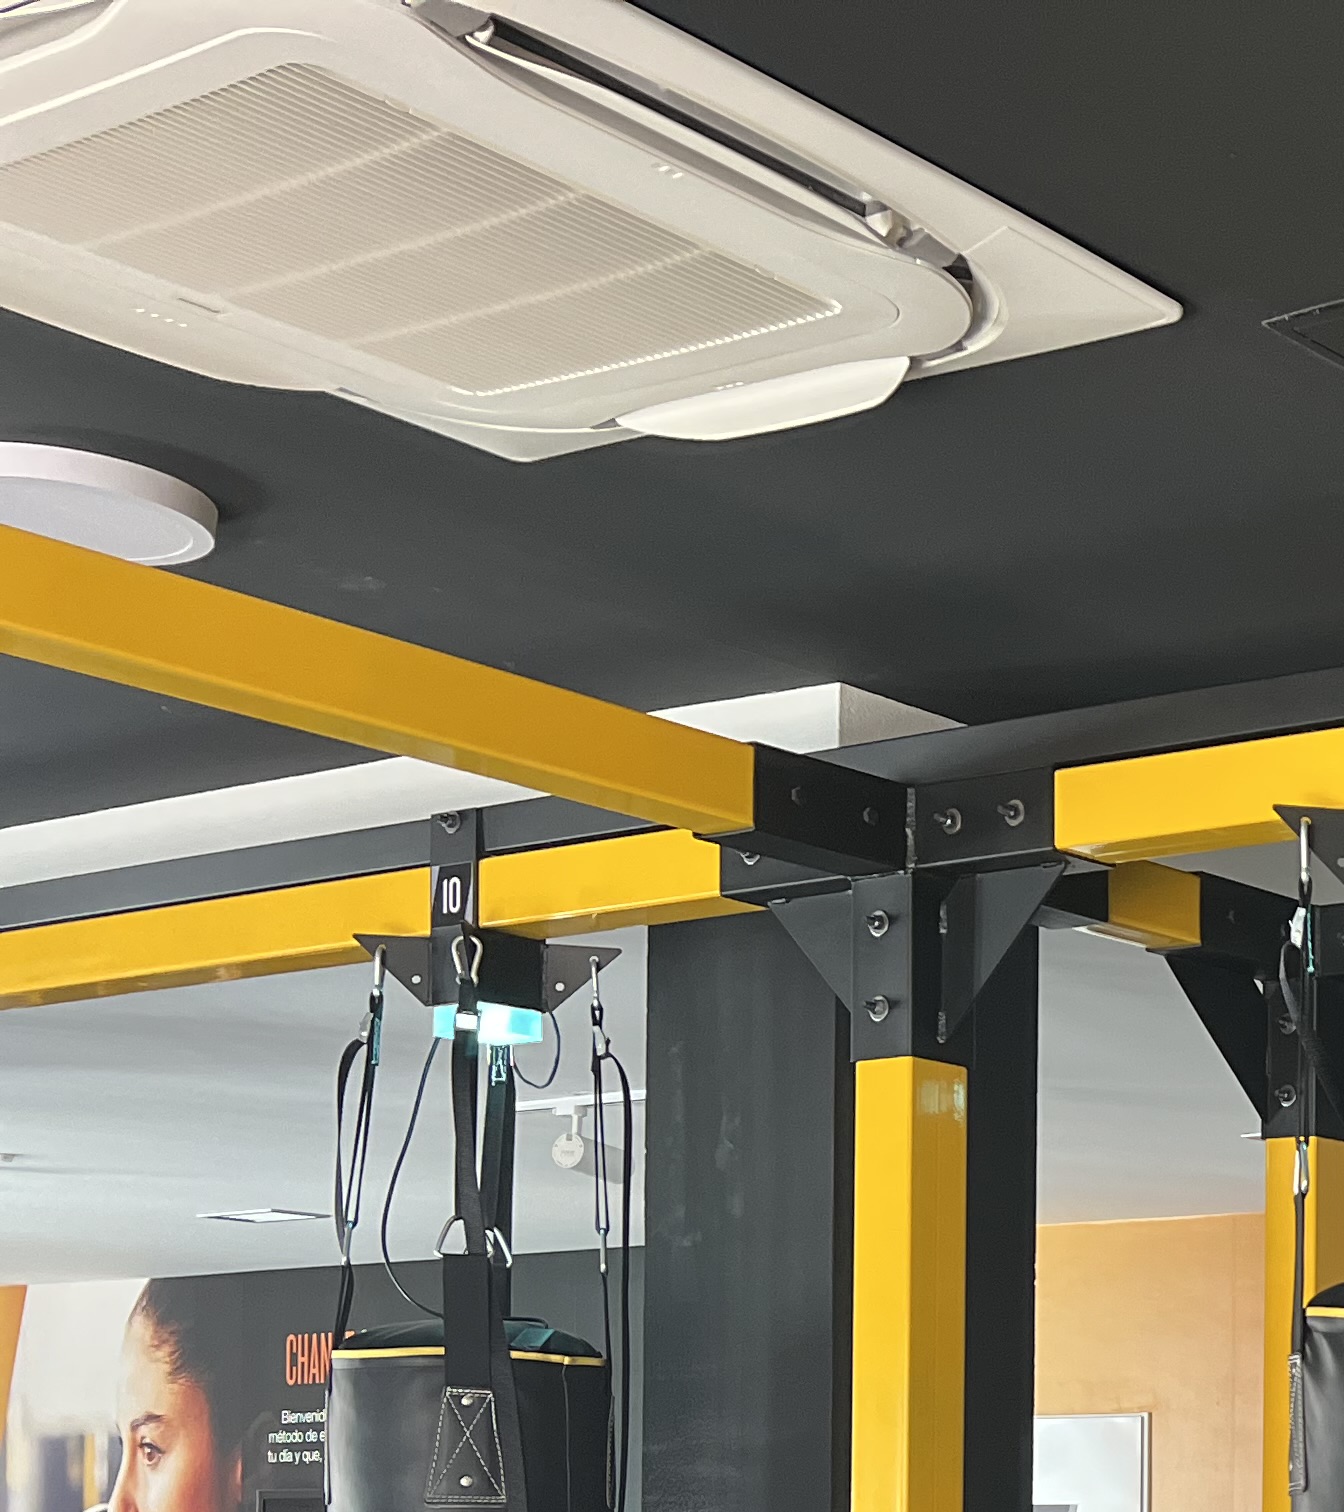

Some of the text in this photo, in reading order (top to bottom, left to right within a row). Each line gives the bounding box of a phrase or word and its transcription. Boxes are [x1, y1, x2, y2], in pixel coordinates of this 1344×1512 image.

[442, 876, 461, 914] 10
[286, 1331, 356, 1386] CHAN
[268, 1428, 304, 1443] método
[305, 1428, 318, 1443] de
[267, 1450, 277, 1463] tu
[278, 1449, 294, 1463] día
[294, 1452, 302, 1465] y
